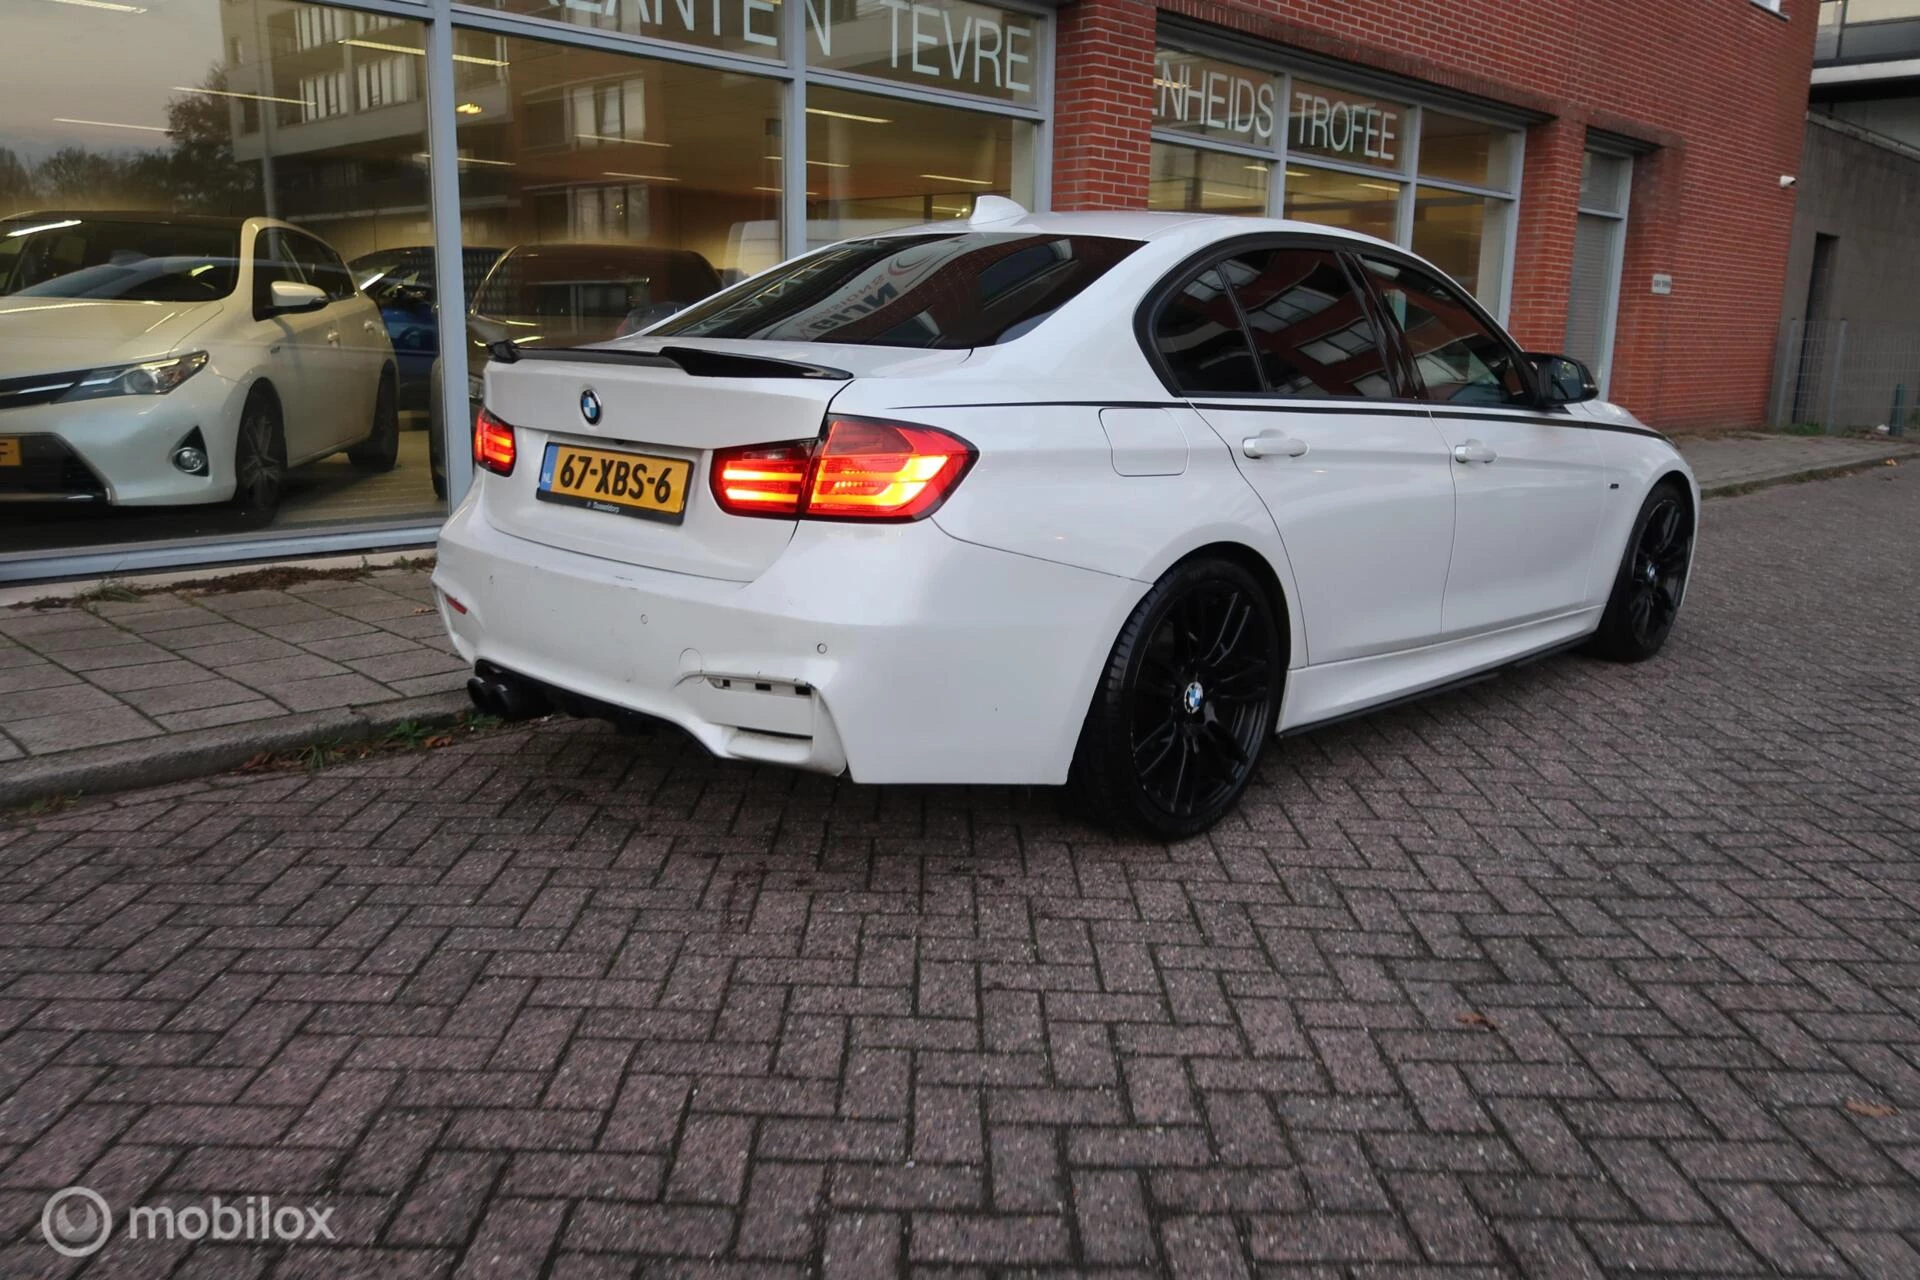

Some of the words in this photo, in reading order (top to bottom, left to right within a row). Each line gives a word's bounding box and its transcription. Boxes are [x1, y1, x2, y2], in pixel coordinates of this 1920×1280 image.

[880, 0, 1031, 92] TEVRE
[1152, 60, 1274, 138] NHEIDS
[1296, 92, 1397, 160] TROFEE
[560, 454, 672, 503] 67-XBS-6
